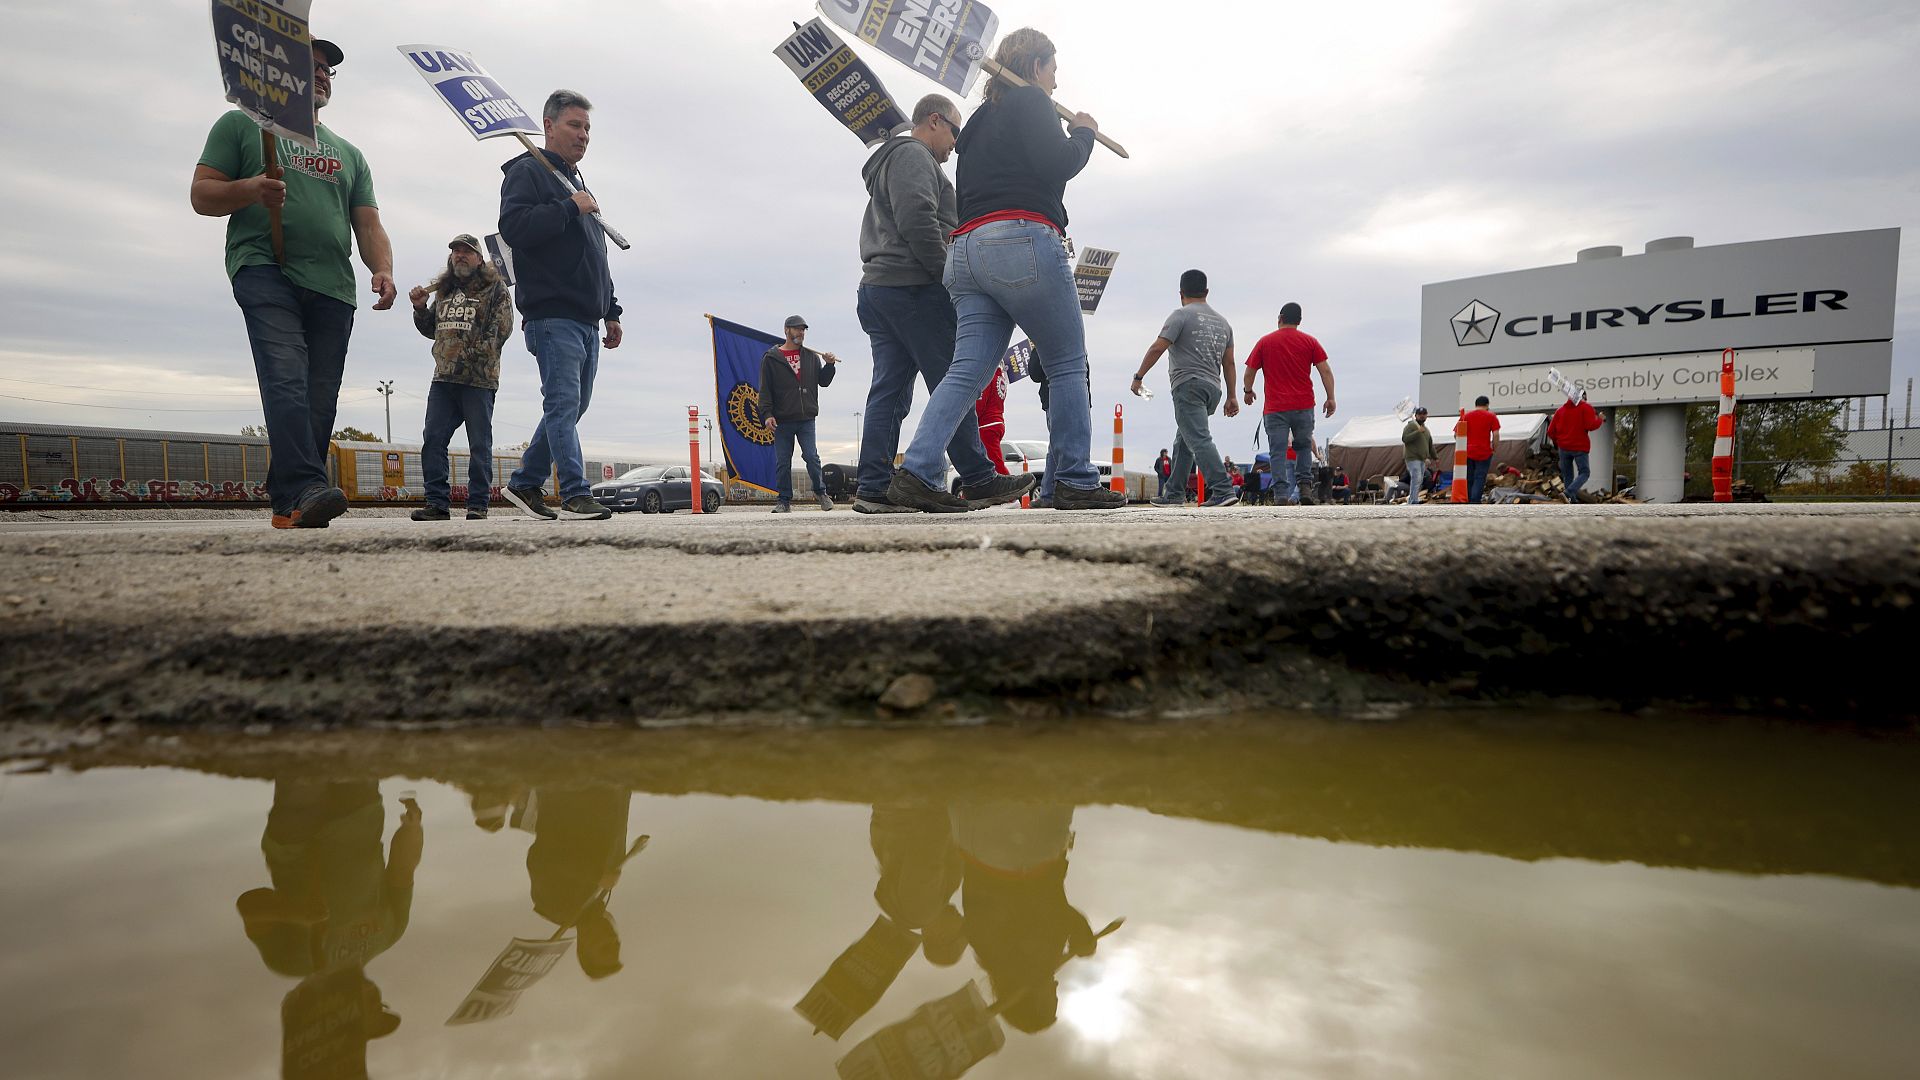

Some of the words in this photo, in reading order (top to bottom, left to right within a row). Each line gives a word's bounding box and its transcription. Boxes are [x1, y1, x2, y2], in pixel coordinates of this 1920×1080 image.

[276, 15, 301, 36] UP
[913, 0, 963, 71] TIERS
[232, 24, 290, 64] COLA
[784, 23, 834, 68] UAW
[220, 40, 264, 79] FAIR
[267, 65, 307, 96] PAY
[409, 51, 483, 75] UAW
[807, 61, 839, 90] STAND
[840, 50, 853, 65] UP
[240, 70, 289, 106] NOW
[462, 80, 493, 101] ON
[826, 71, 861, 102] RECORD
[834, 80, 871, 111] PROFITS
[465, 99, 526, 130] STRIKE
[844, 92, 879, 121] RECORD
[304, 157, 343, 176] POP
[1077, 267, 1099, 276] STAND
[1085, 249, 1114, 267] UAW
[1076, 278, 1101, 287] SAVING
[439, 303, 476, 320] Jeep
[1504, 290, 1848, 337] CHRYSLER
[1010, 354, 1020, 373] NOW
[1012, 345, 1023, 362] FAIR
[1018, 362, 1027, 376] PAY
[1488, 378, 1551, 397] Toledo
[1557, 371, 1664, 391] ssembly
